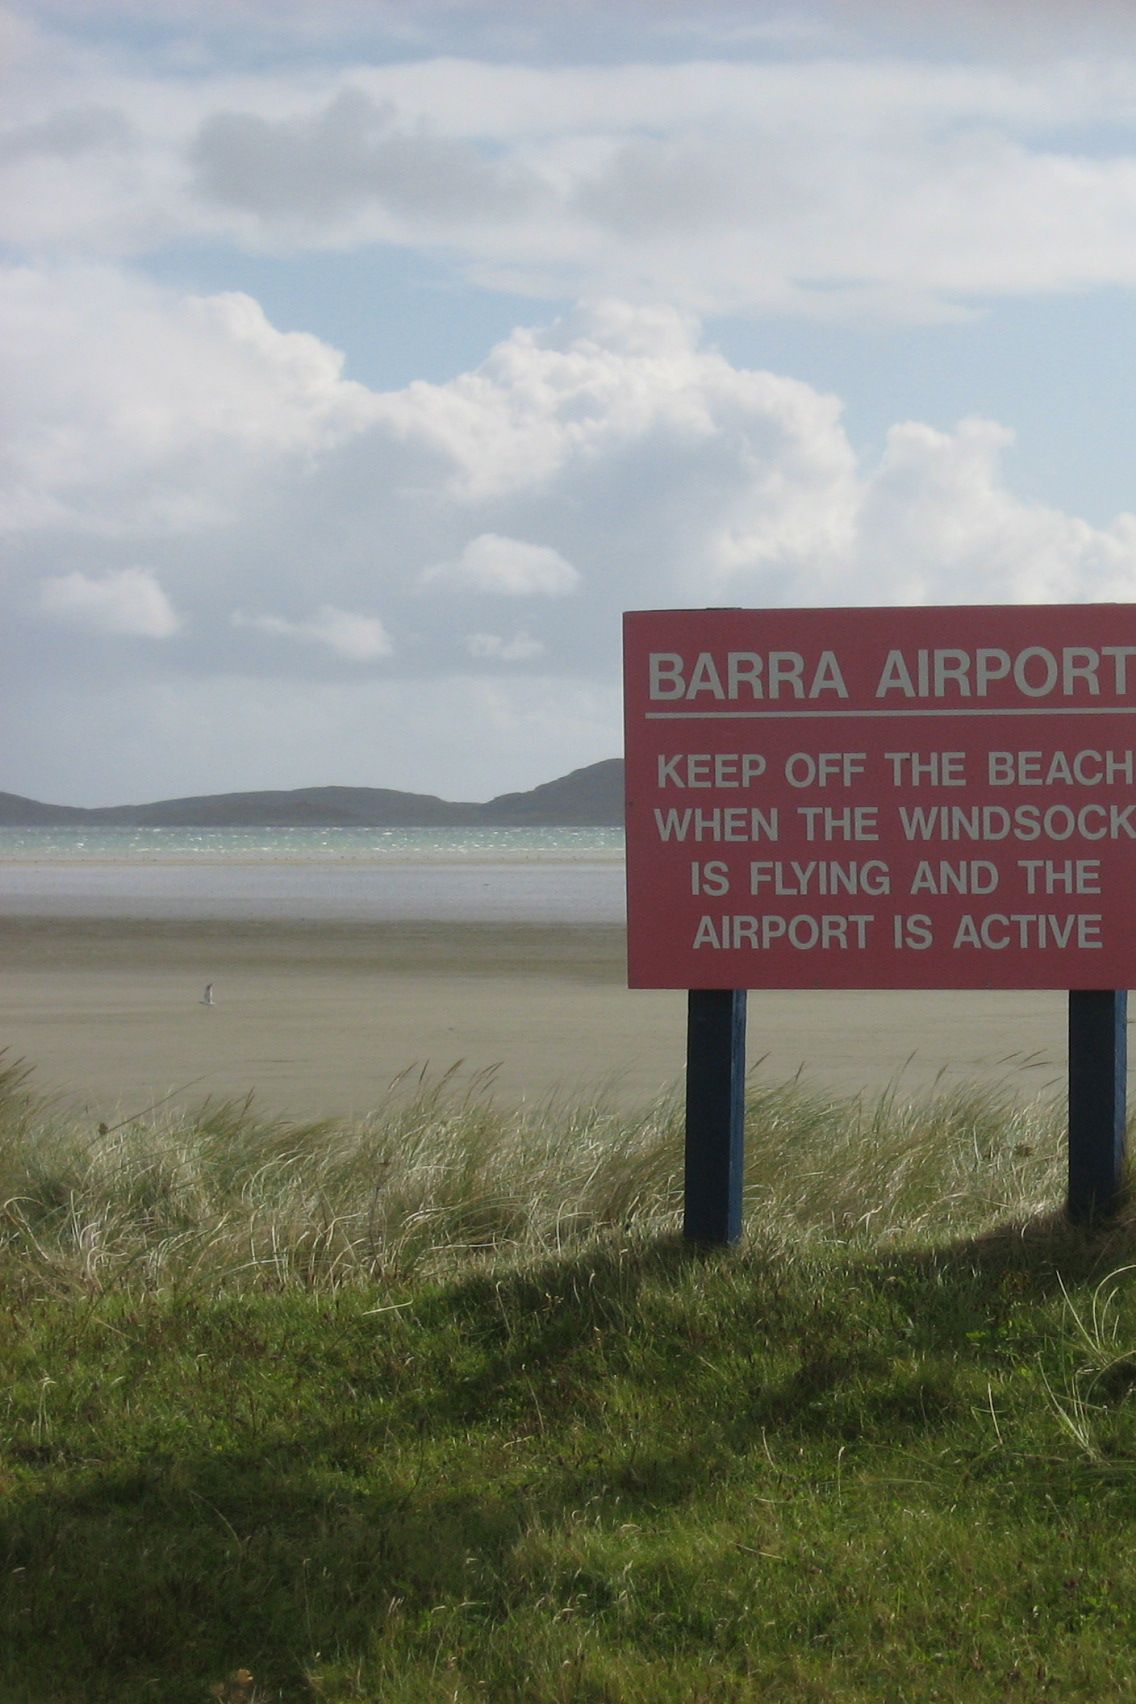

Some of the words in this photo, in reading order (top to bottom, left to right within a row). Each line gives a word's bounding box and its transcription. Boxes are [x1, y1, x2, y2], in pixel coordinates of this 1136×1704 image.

[649, 651, 849, 700] BARRA
[657, 754, 767, 788] KEEP
[785, 753, 866, 787] OFF
[885, 752, 966, 786] THE
[988, 750, 1134, 785] BEACH
[654, 808, 779, 842] WHEN
[797, 807, 879, 841] THE
[691, 861, 729, 896] IS
[750, 860, 890, 895] FLYING
[911, 860, 999, 894] AND
[1018, 860, 1101, 894] THE
[693, 915, 874, 949] AIRPORT
[894, 915, 933, 949] IS
[953, 914, 1103, 949] ACTIVE
